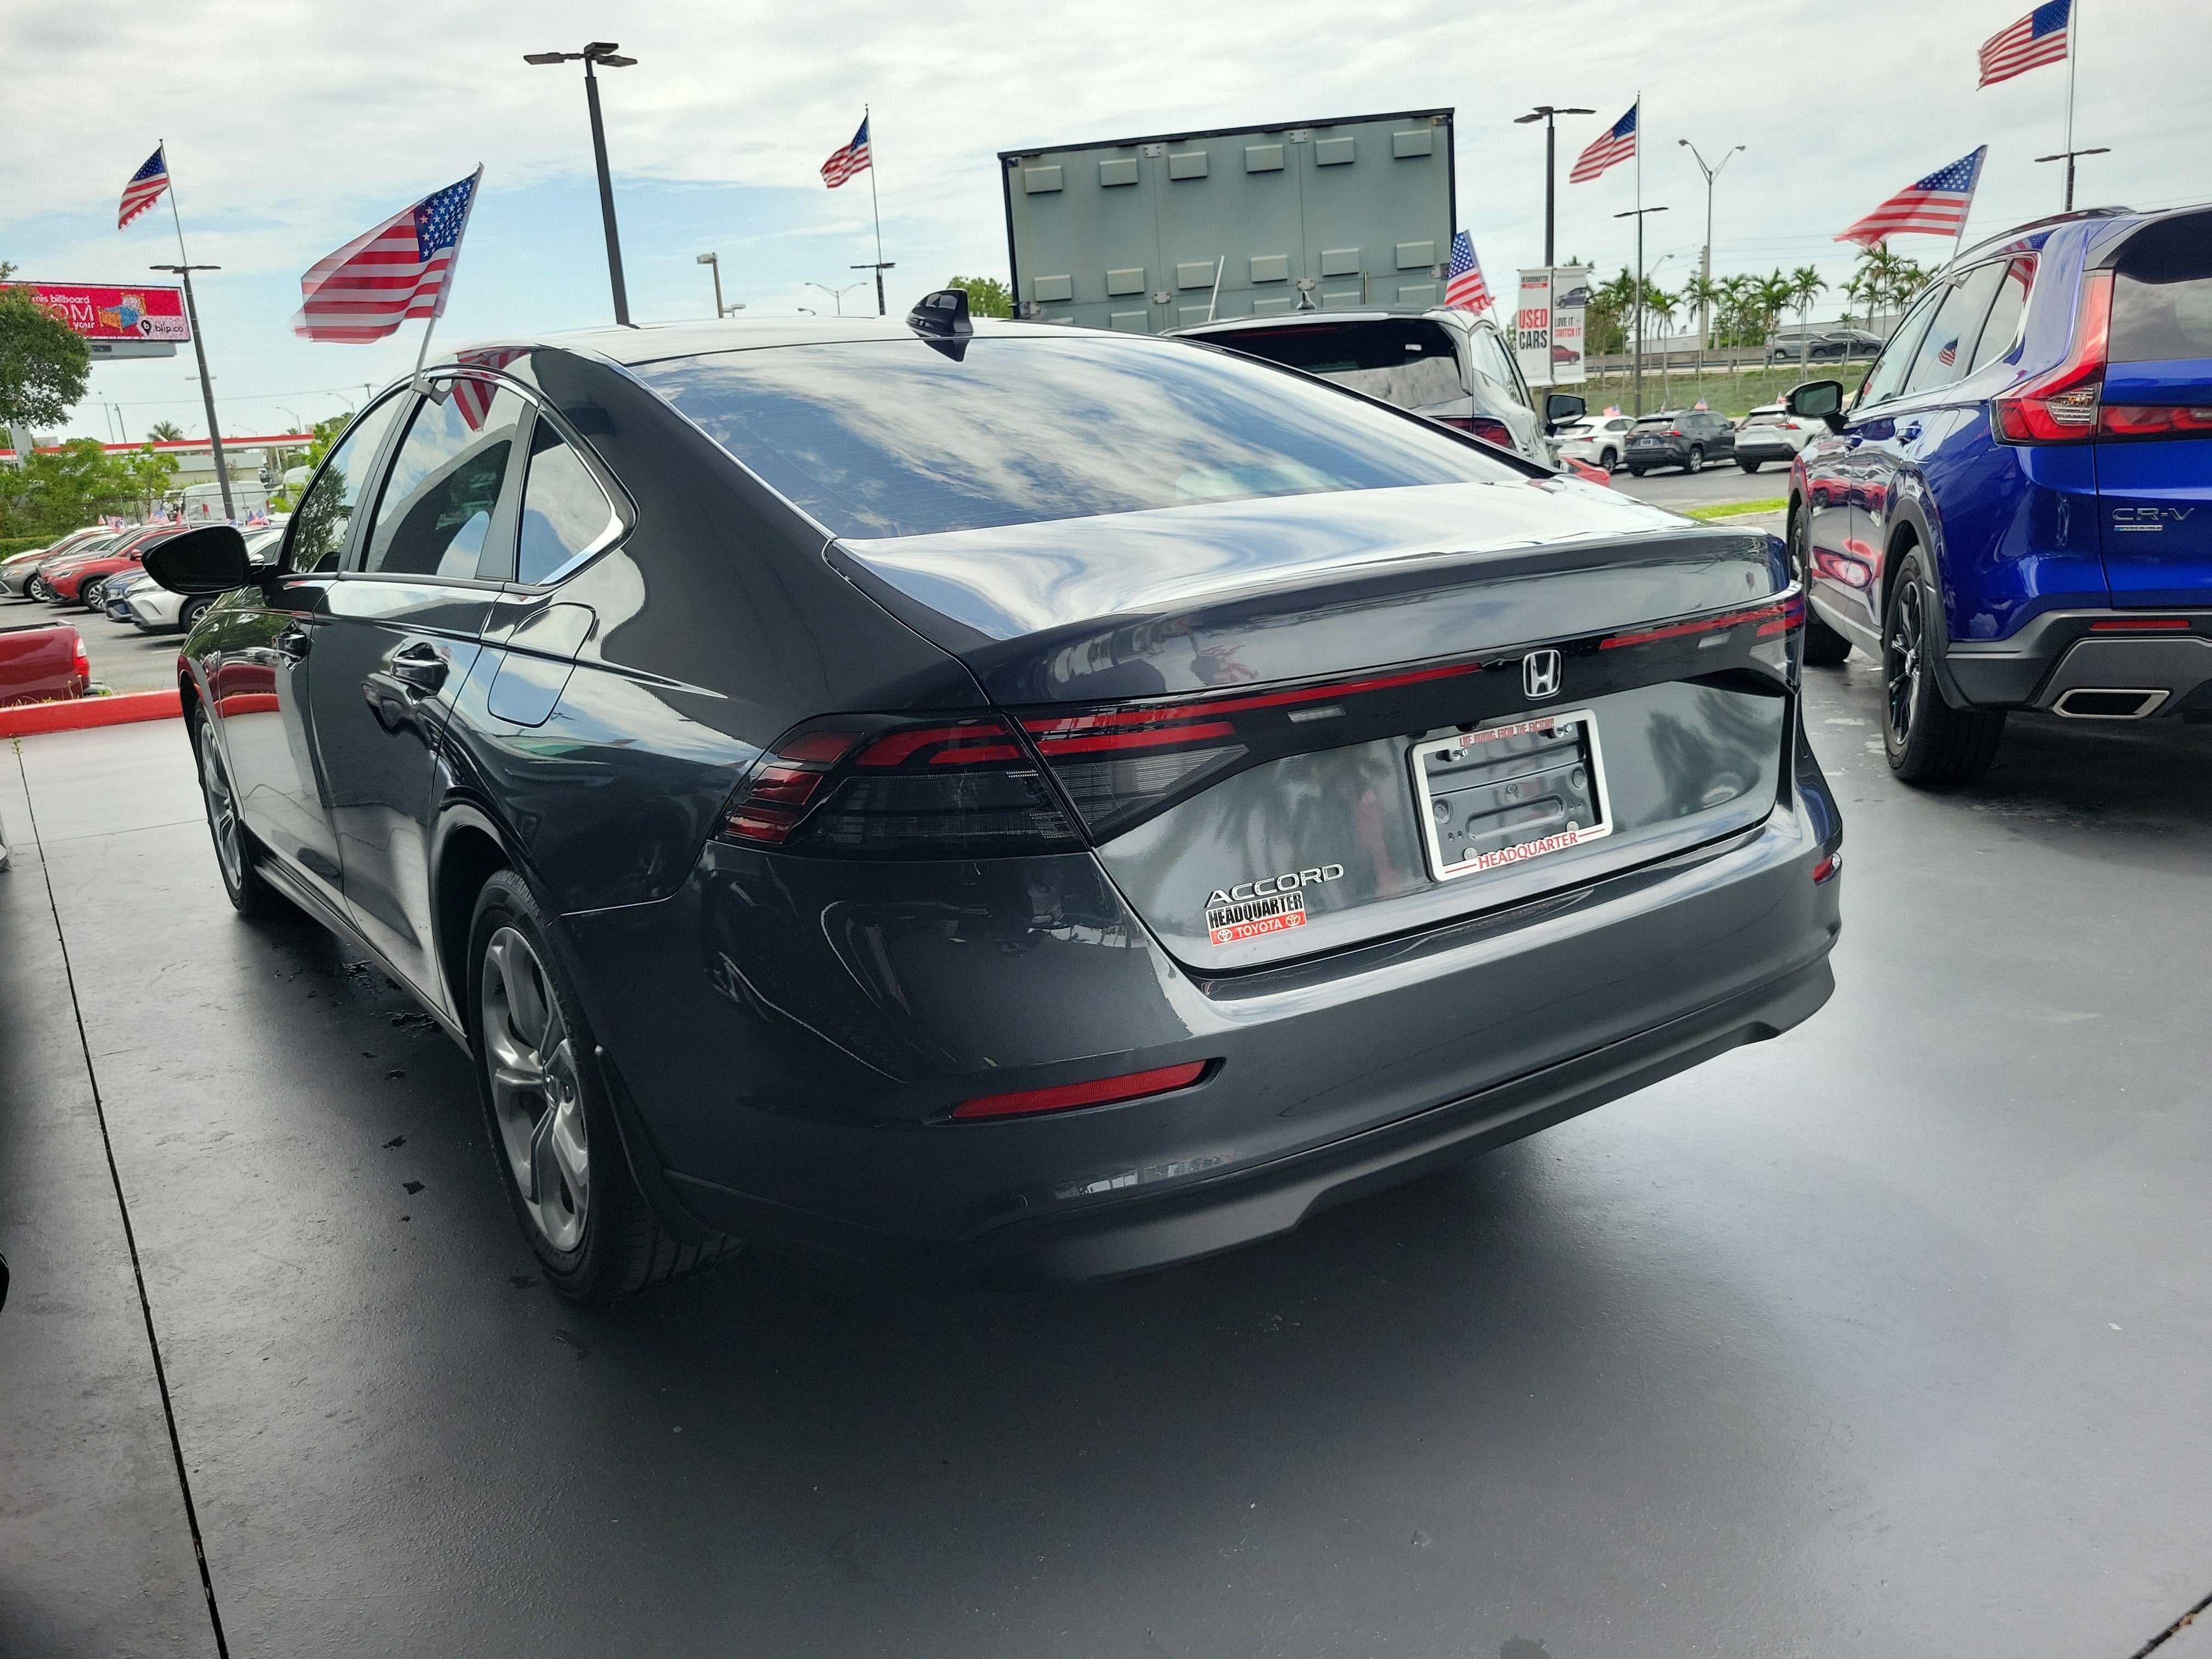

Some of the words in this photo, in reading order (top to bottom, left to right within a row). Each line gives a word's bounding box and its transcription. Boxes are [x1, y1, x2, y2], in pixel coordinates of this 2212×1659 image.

[50, 294, 91, 304] billboard
[73, 321, 95, 330] your
[1519, 309, 1547, 329] USED
[1554, 317, 1567, 327] LOVE
[1568, 317, 1574, 326] IT
[155, 324, 184, 334] blip.co
[1575, 328, 1581, 337] IT
[1519, 330, 1547, 350] CARS
[2112, 508, 2194, 521] CR-V
[1498, 727, 1514, 740] FROM
[1516, 724, 1527, 736] THE
[1478, 832, 1578, 870] HEADQUARTER
[1204, 864, 1344, 909] ACCORD
[1208, 893, 1303, 929] HEADQUARTER
[1236, 919, 1283, 939] TOYOTA
